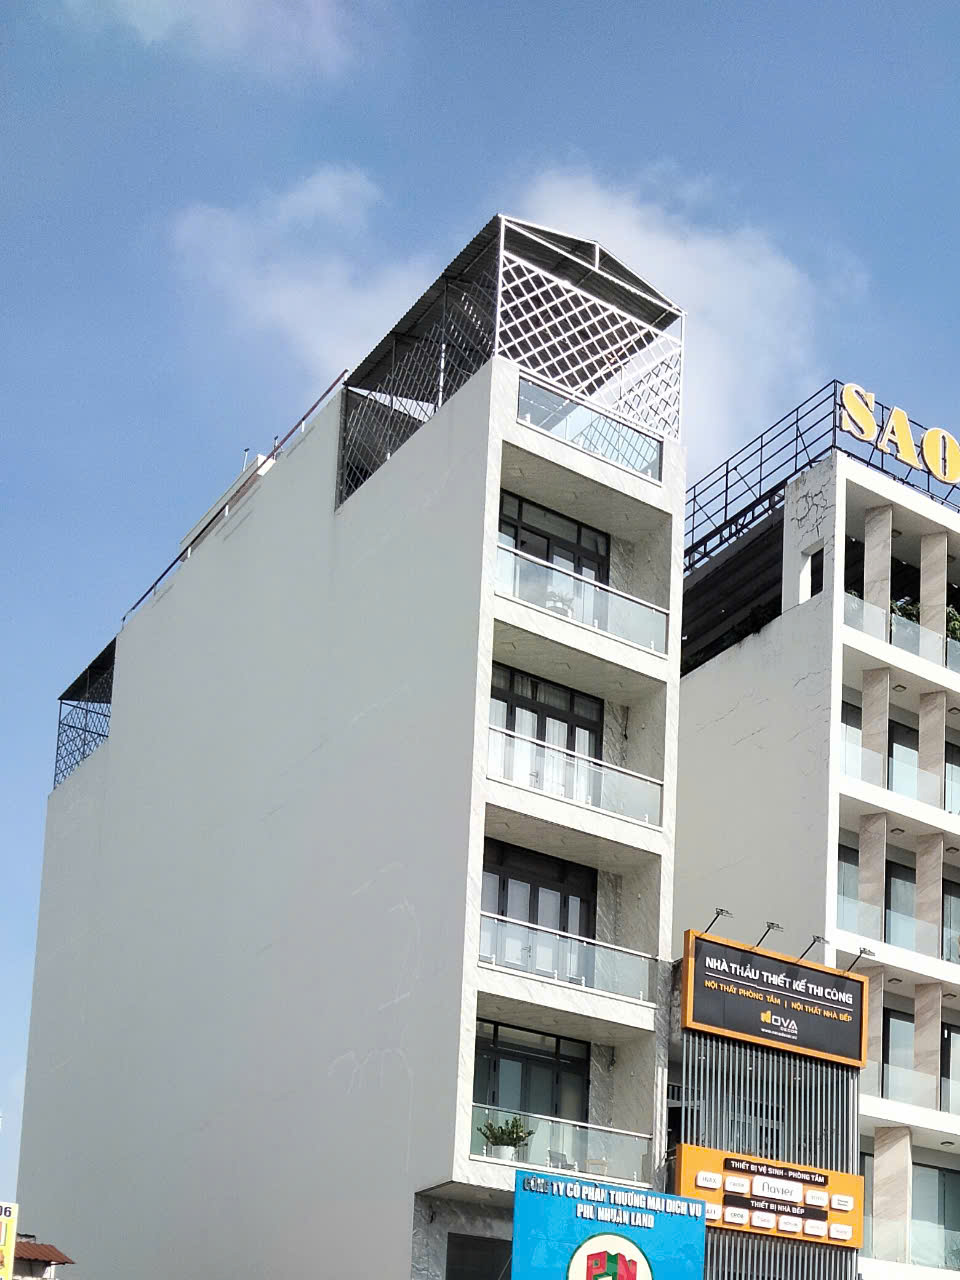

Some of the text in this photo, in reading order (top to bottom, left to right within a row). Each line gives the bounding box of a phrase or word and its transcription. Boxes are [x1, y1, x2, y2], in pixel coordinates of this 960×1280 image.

[704, 980, 718, 989] NỘI
[720, 983, 737, 994] THẤT
[738, 988, 763, 1001] PHÒNG
[705, 957, 853, 1004] NHÀ THẦU THIẾT KẾ THI CÔNG
[731, 1161, 749, 1170] THIẾT
[750, 1164, 758, 1173] BỊ
[758, 1165, 768, 1174] VỆ
[768, 1168, 784, 1177] SINH
[788, 1171, 810, 1182] PHÒNG
[551, 1181, 565, 1197] TY
[581, 1183, 608, 1204] PHẦN
[609, 1190, 646, 1210] THƯƠNG
[647, 1196, 665, 1214] MẠI
[665, 1199, 688, 1217] DỊCH
[688, 1203, 703, 1221] VỤ
[751, 1200, 768, 1210] THIẾT
[769, 1203, 777, 1212] BỊ
[778, 1204, 791, 1213] NHÀ
[597, 1206, 630, 1227] NHUẬN
[630, 1211, 655, 1229] LAND
